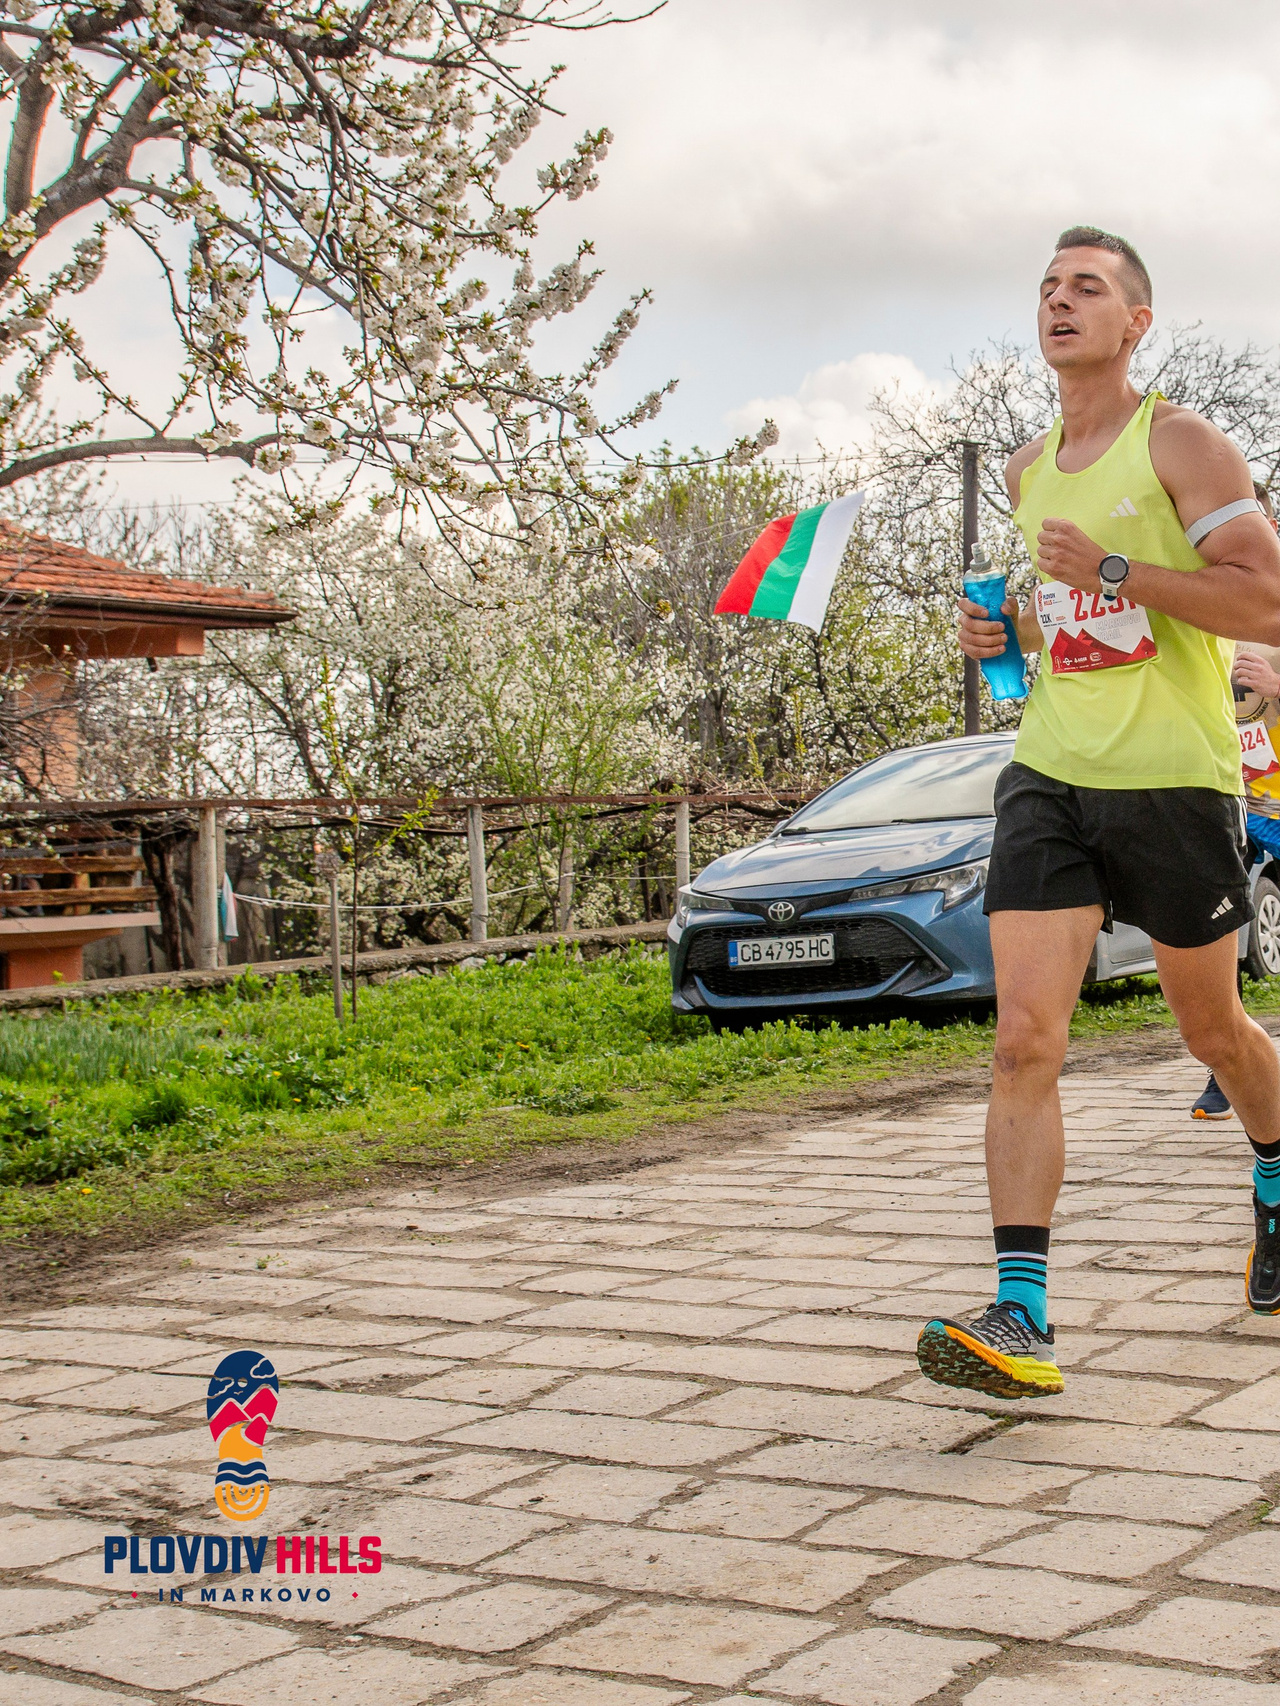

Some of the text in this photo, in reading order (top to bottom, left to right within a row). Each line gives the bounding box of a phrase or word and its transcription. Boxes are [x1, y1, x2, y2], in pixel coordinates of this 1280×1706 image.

[1095, 612, 1141, 631] MARKOVO
[1096, 628, 1123, 641] TRAIL
[1239, 727, 1266, 753] 324
[740, 938, 830, 962] CB 4795 HC
